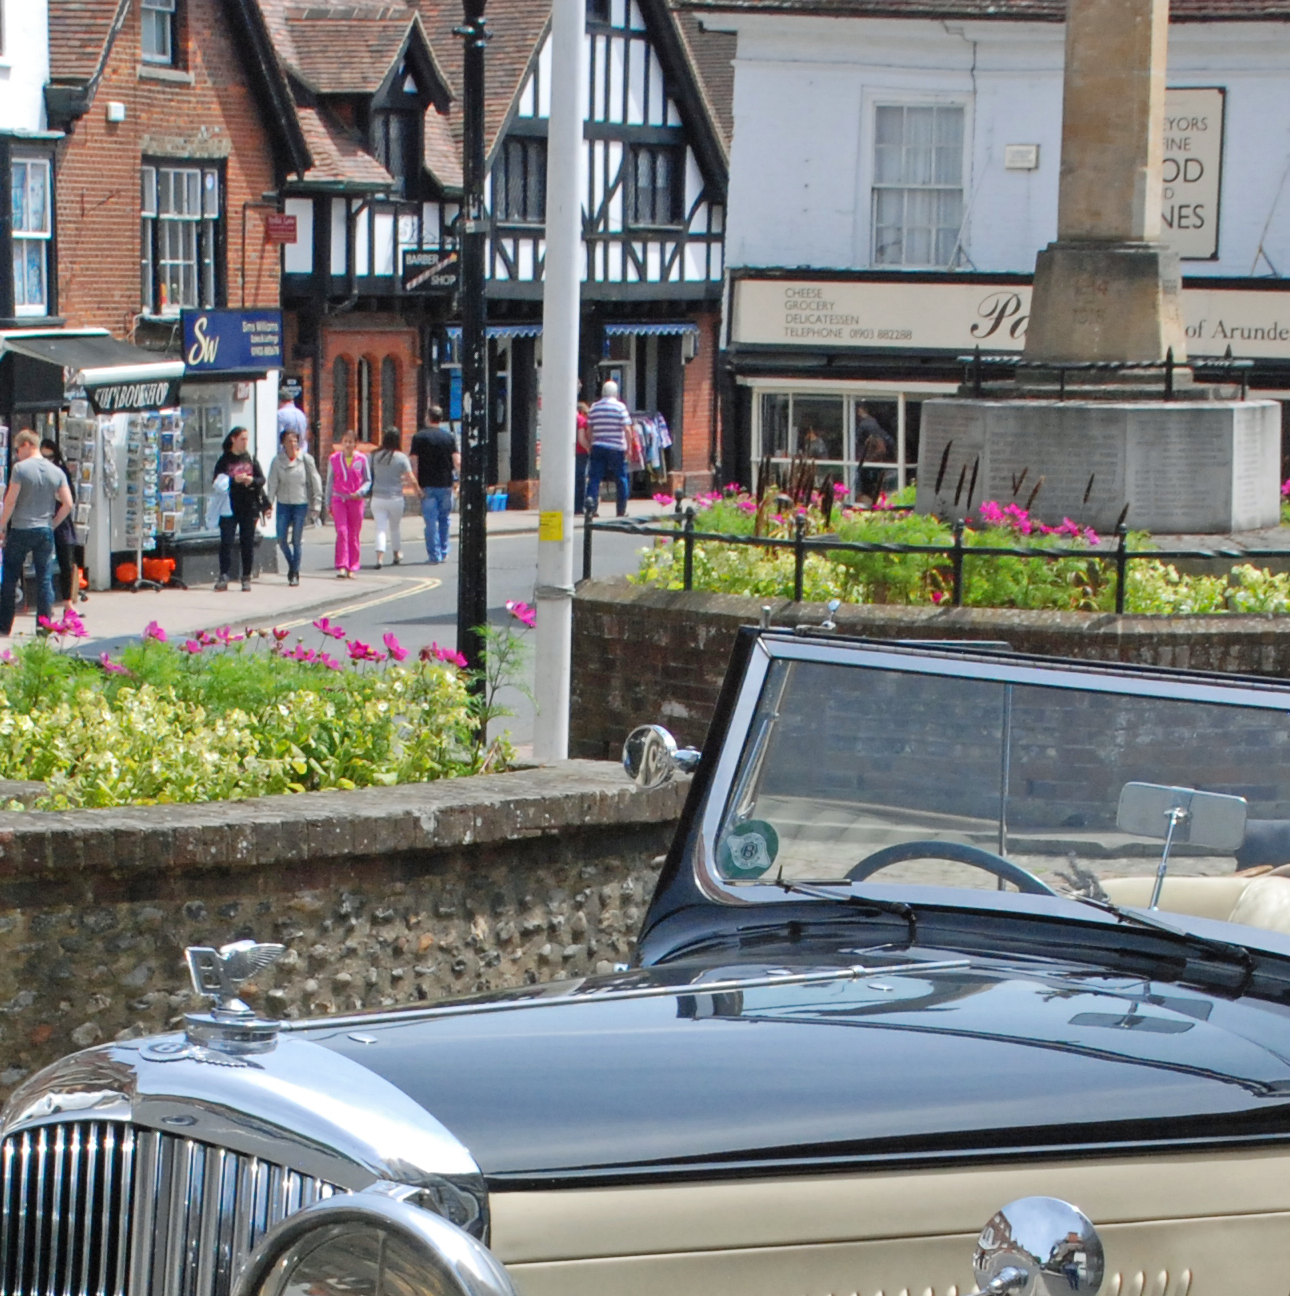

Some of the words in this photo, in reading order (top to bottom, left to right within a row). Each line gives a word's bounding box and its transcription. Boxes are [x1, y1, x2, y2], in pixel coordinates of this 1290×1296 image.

[1162, 158, 1205, 183] OD
[1162, 204, 1205, 229] NES
[405, 253, 439, 265] BARBER
[431, 275, 456, 286] SHOP
[785, 288, 823, 299] CHEESE
[784, 300, 836, 311] GROCERY
[785, 313, 860, 325] DELICATESSEN
[784, 327, 844, 339] TELEPHONE
[849, 328, 875, 340] 01903
[1185, 319, 1206, 339] of
